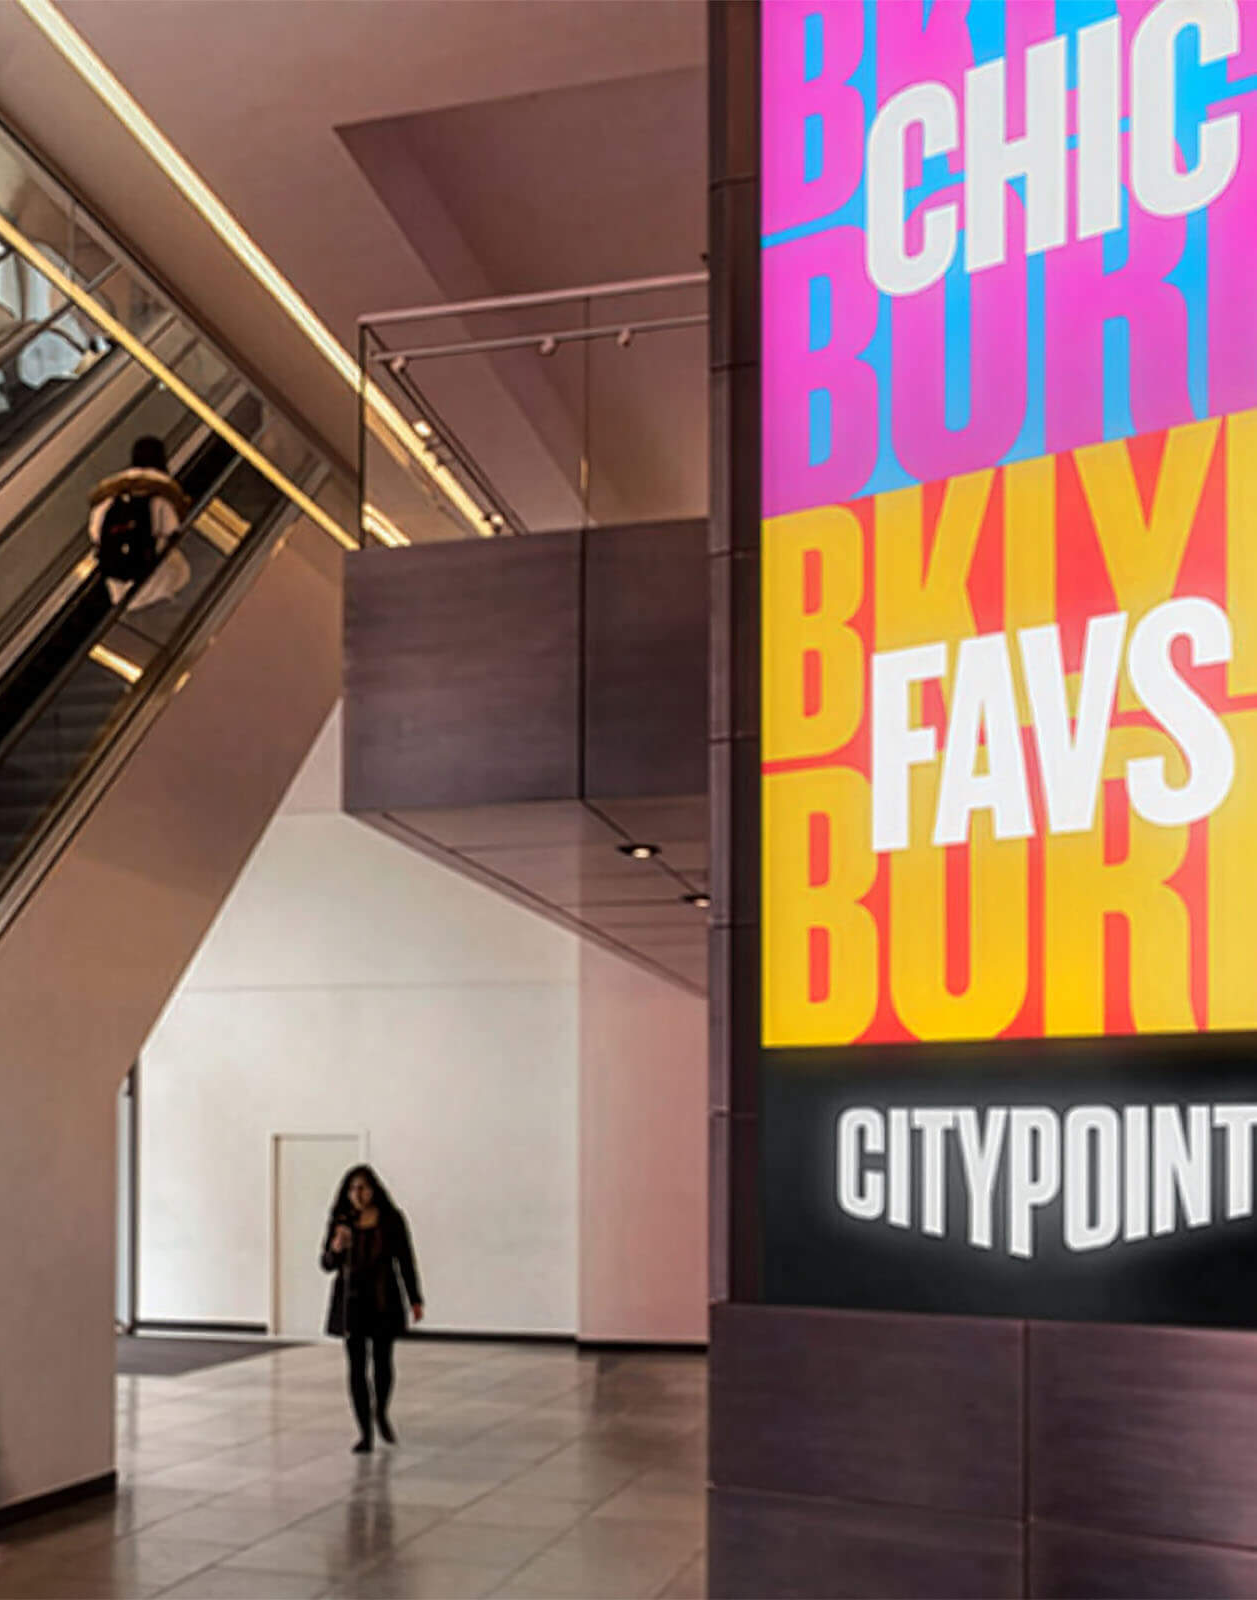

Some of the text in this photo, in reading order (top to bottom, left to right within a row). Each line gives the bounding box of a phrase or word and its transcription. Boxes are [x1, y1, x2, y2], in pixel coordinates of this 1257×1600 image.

[866, 0, 1241, 297] CHIC
[871, 596, 1236, 854] FAVS
[837, 1103, 1257, 1259] CITYPOINT
